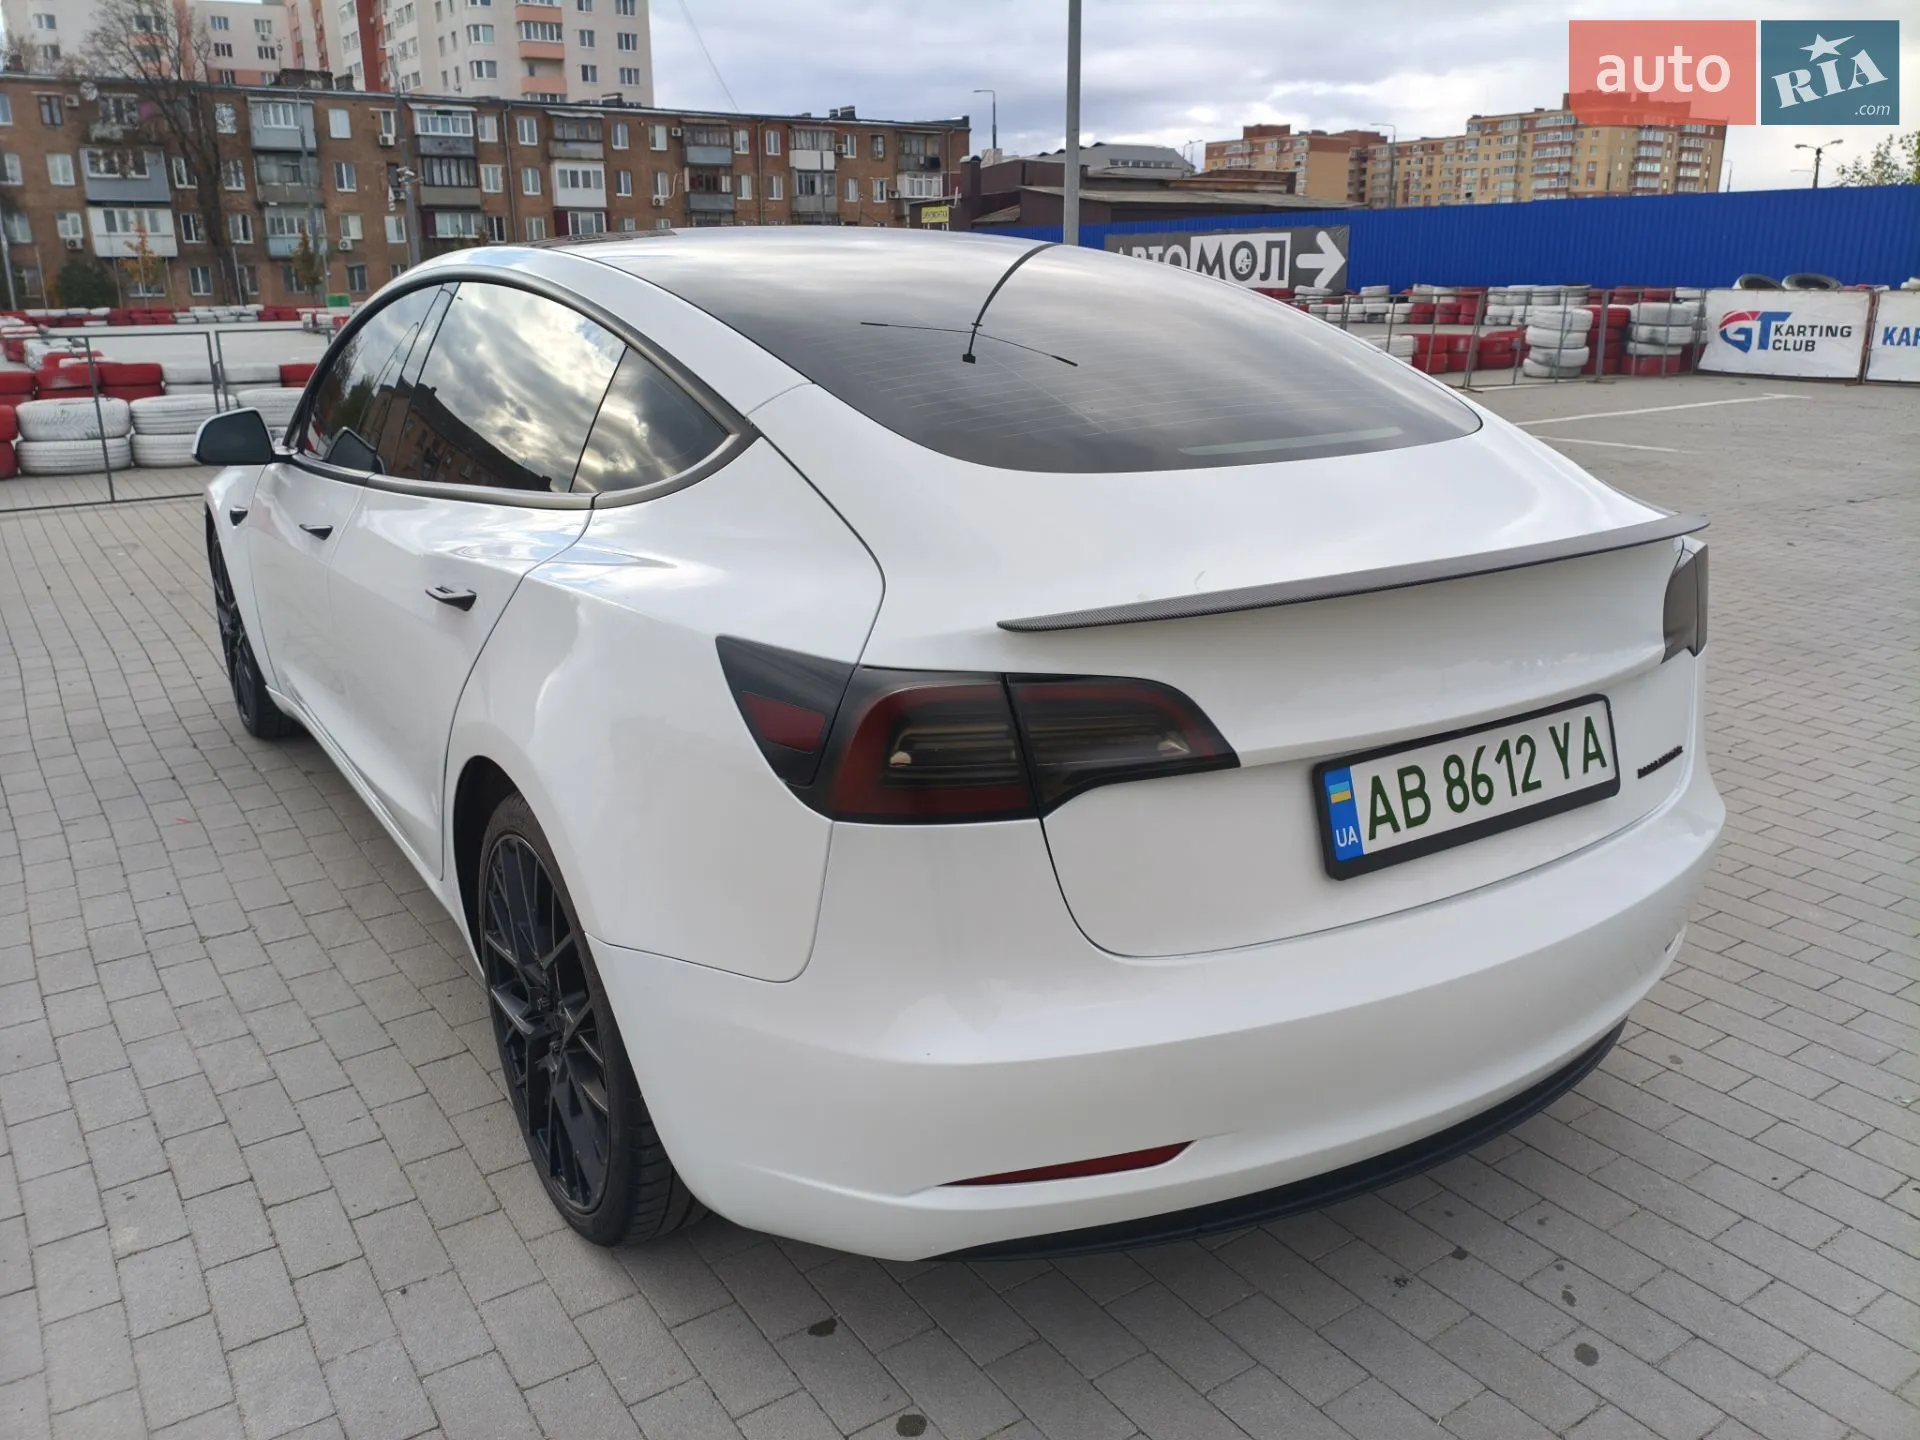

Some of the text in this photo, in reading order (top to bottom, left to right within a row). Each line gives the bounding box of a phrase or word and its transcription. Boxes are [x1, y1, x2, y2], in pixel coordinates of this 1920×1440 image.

[1118, 240, 1287, 282] ТОМОЛ
[1719, 310, 1793, 353] GT
[1772, 338, 1816, 352] CLUB
[1773, 324, 1853, 338] KARTING
[1368, 764, 1432, 841] AB
[1442, 733, 1543, 814] 8612
[1548, 715, 1608, 780] YA
[1335, 825, 1359, 848] UA
